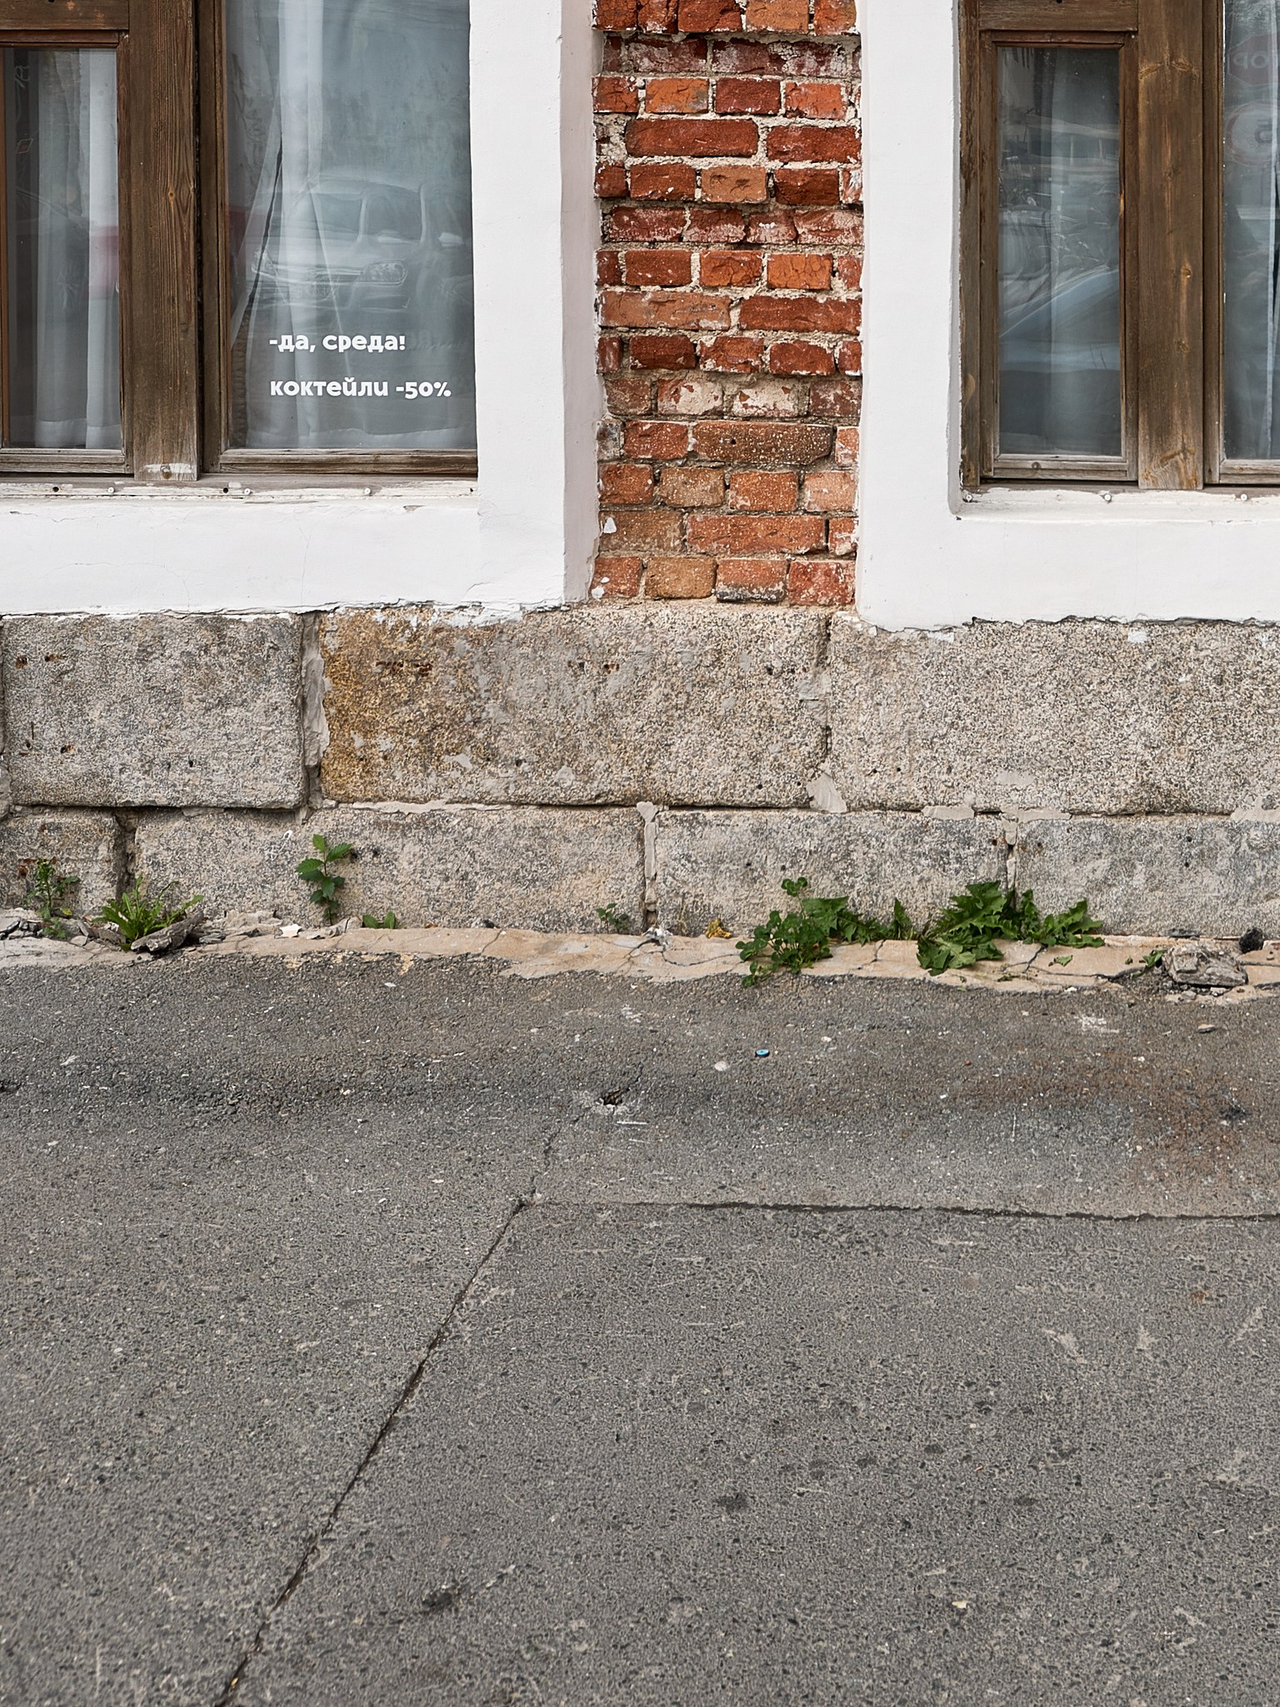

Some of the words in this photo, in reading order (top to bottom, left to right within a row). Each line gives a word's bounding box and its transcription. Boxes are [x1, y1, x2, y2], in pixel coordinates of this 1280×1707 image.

[269, 334, 316, 353] -да,
[322, 334, 406, 353] среда!
[270, 377, 389, 397] коктейли
[395, 381, 452, 400] -50%
